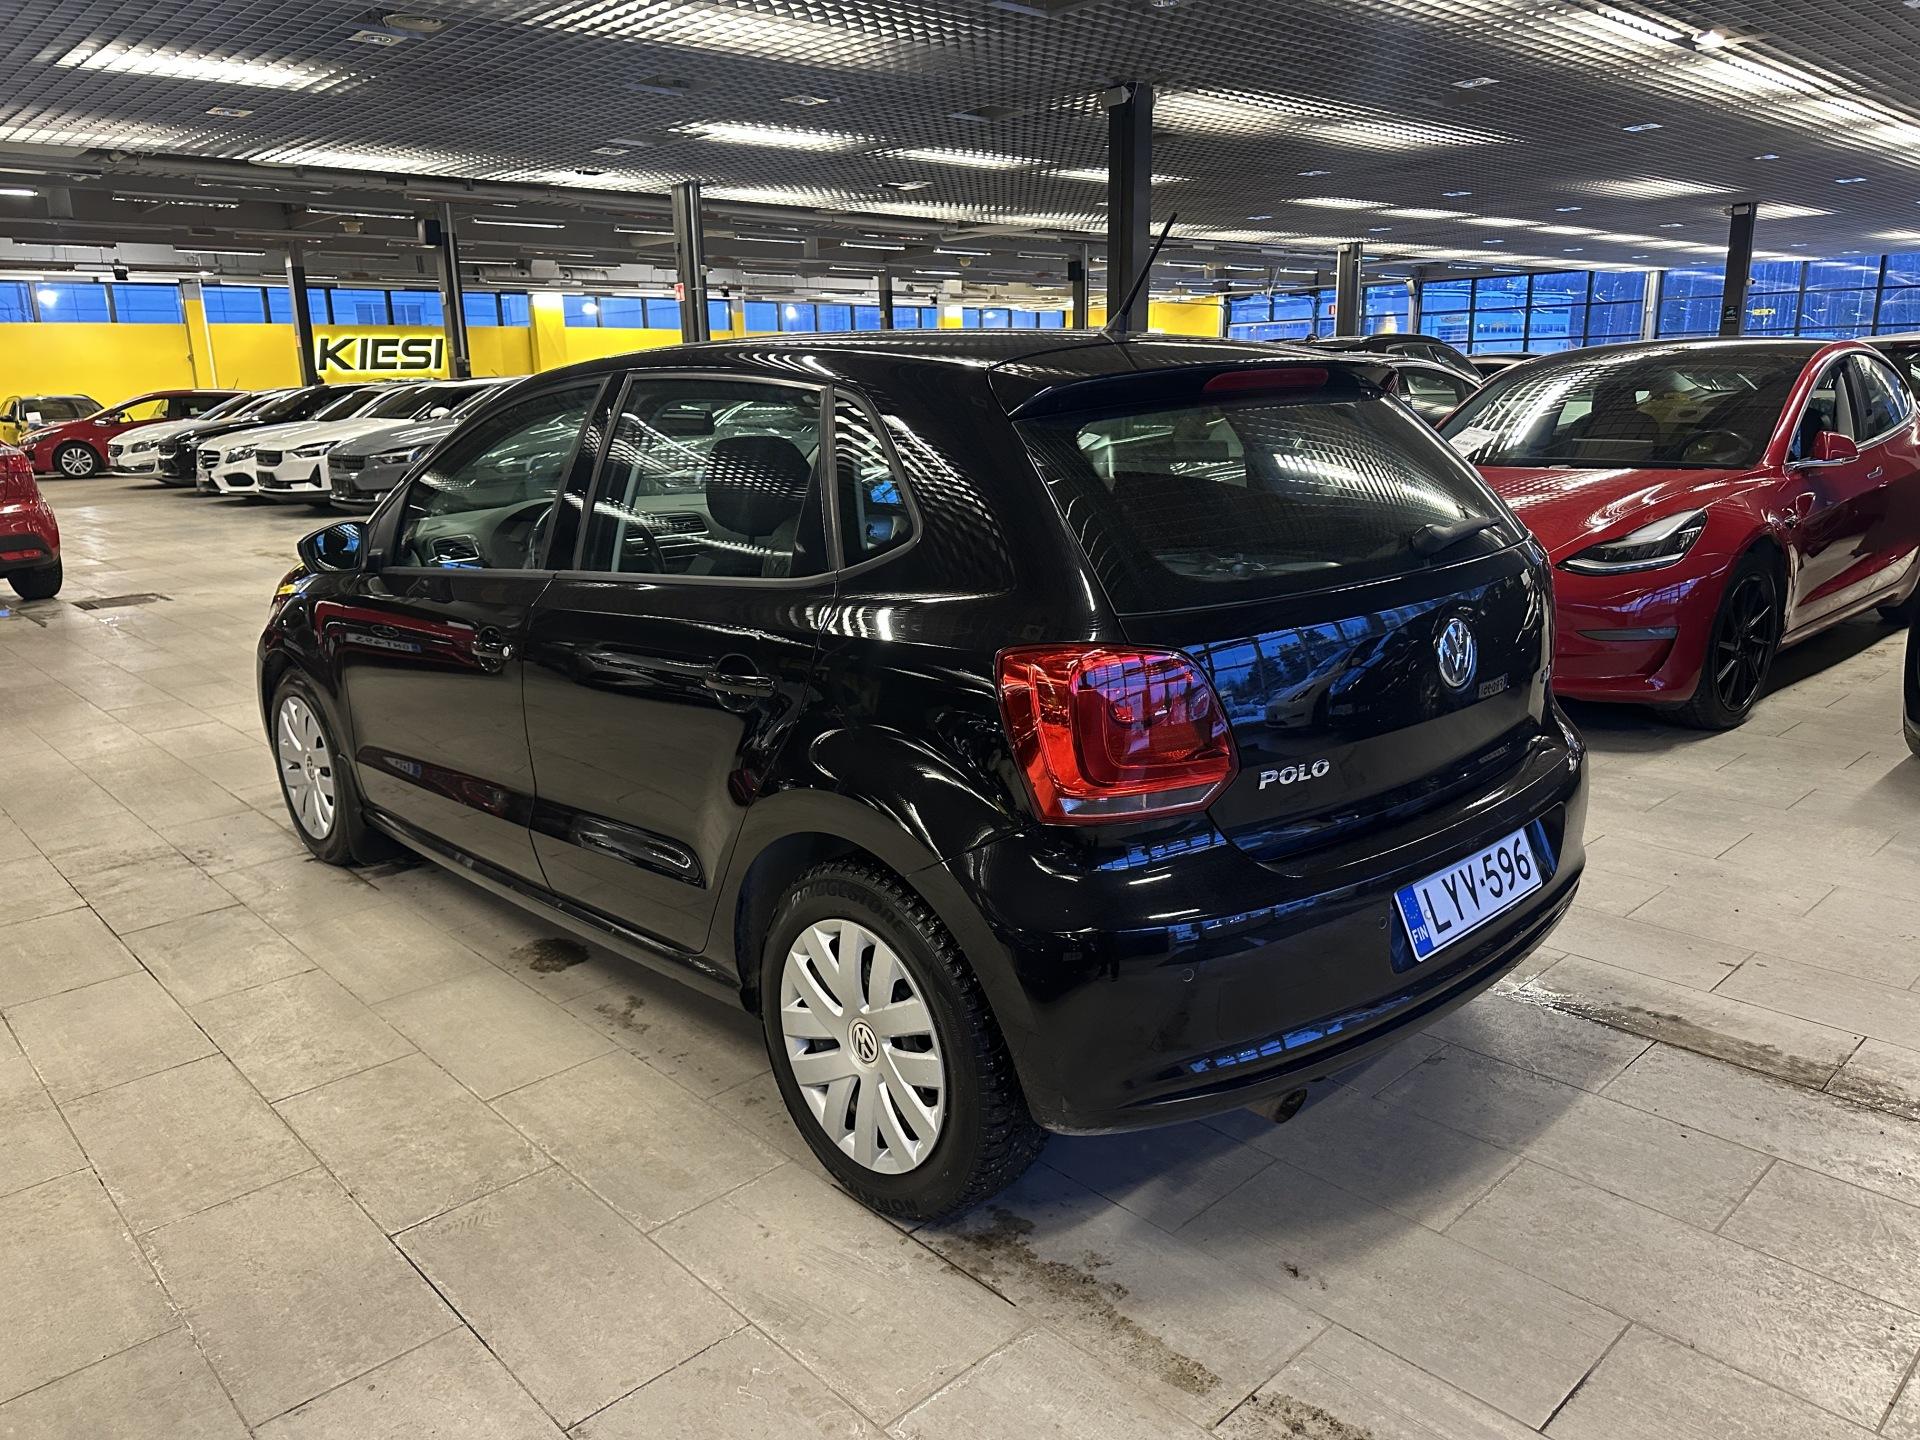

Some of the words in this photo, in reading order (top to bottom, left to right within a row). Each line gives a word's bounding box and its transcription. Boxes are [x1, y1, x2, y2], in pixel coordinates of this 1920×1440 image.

[318, 338, 444, 370] KIESI
[1258, 759, 1330, 790] POLO
[1422, 837, 1532, 934] LYV-596
[1411, 924, 1430, 944] FIN
